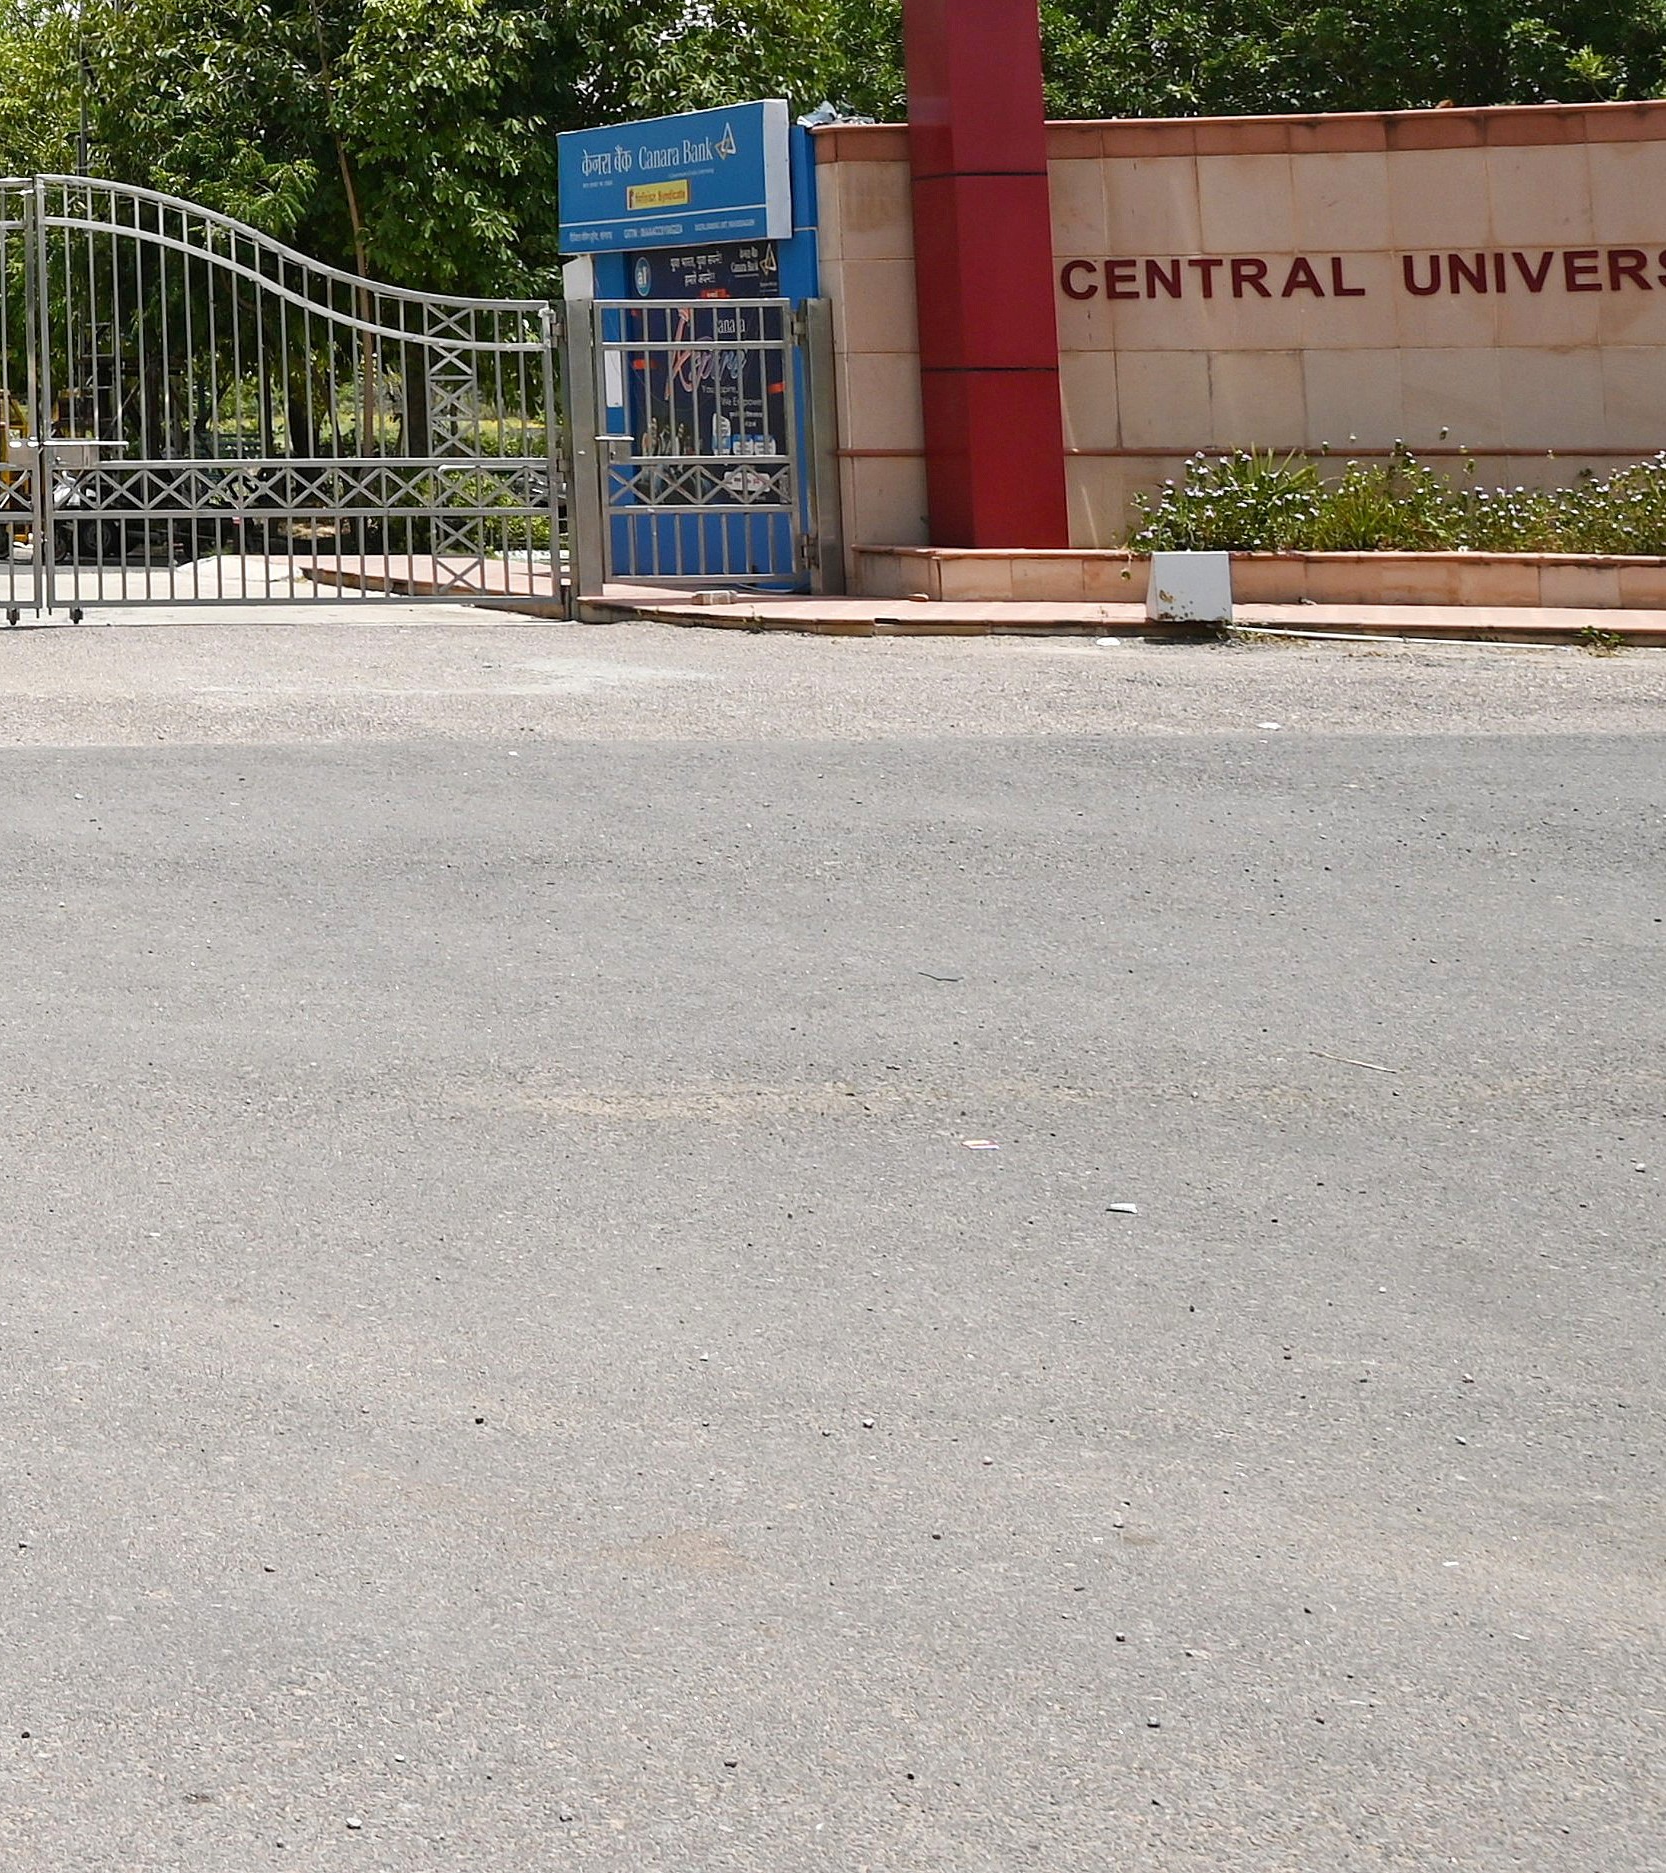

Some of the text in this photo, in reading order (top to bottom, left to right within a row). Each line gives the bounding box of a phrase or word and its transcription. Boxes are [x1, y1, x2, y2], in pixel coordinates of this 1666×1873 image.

[581, 149, 611, 176] केनरा
[638, 136, 713, 170] Canara Bank
[1060, 249, 1666, 300] CENTRAL UNIVER
